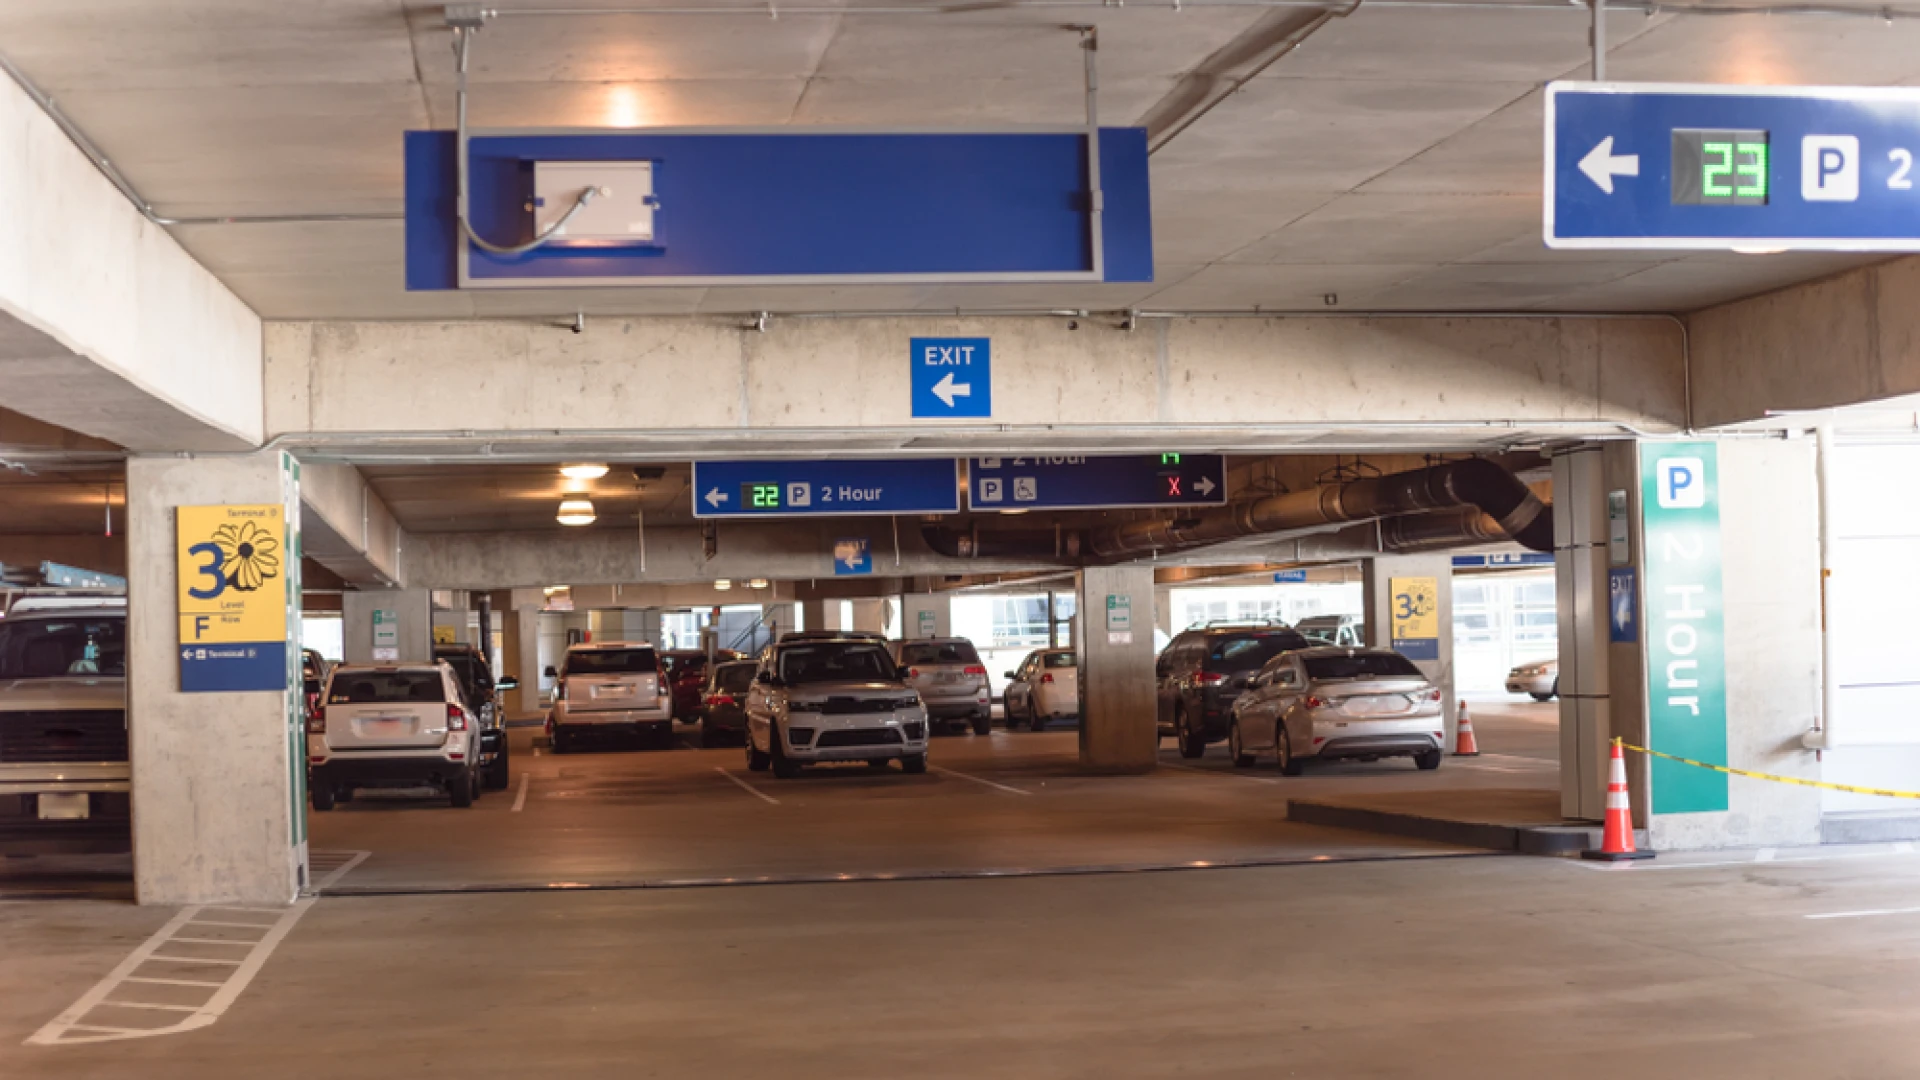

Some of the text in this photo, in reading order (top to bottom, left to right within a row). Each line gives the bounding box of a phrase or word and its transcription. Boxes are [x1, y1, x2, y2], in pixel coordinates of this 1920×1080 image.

[1703, 141, 1768, 197] 23
[1817, 146, 1913, 190] P 2
[924, 345, 976, 366] EXIT
[752, 485, 779, 506] 22
[792, 486, 884, 503] P 2 Hour
[985, 481, 998, 498] P
[1168, 477, 1181, 496] X
[1668, 466, 1693, 501] P
[187, 541, 227, 600] 3
[1395, 593, 1412, 619] 3
[195, 615, 210, 640] F
[1664, 532, 1706, 717] 2 Hour
